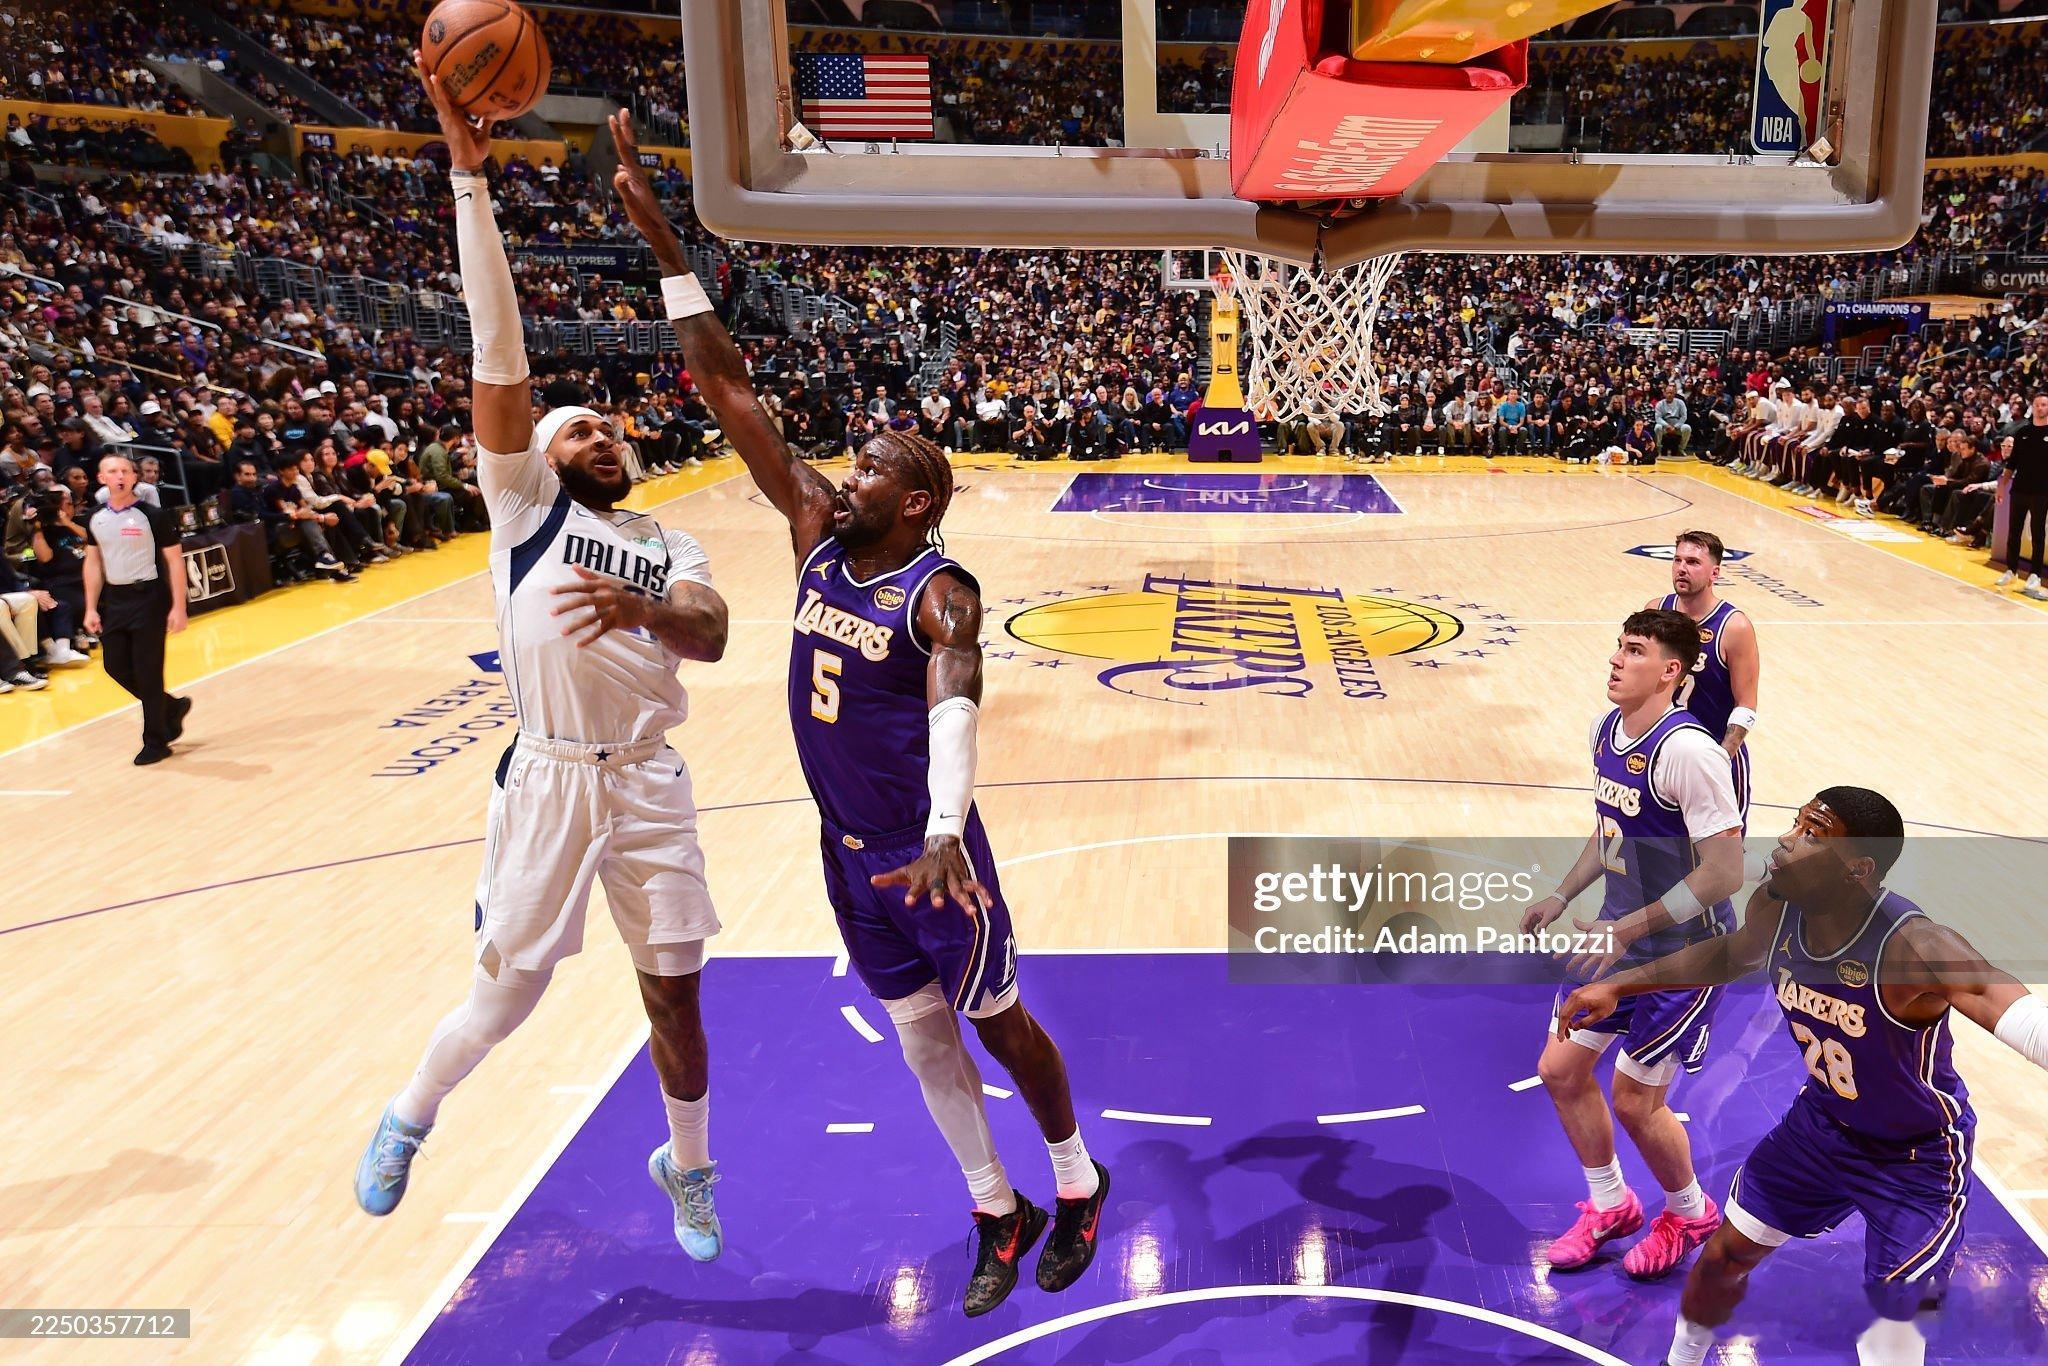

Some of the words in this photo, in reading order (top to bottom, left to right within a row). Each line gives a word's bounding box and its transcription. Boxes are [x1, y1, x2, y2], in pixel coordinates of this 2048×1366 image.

[1761, 116, 1793, 143] NBA
[567, 255, 617, 266] EXPRESS
[2000, 270, 2048, 289] crypt
[1836, 303, 1851, 315] 17x
[1852, 303, 1910, 316] CHAMPIONS
[563, 534, 668, 593] DALLAS
[794, 587, 894, 662] LAKERS
[877, 590, 905, 605] bibigo
[1315, 604, 1357, 628] LOS
[1097, 573, 1345, 706] LAKERS
[1322, 626, 1388, 700] ANGELES
[378, 679, 503, 730] ARENA
[811, 648, 843, 724] 5
[1597, 812, 1627, 876] 12
[1839, 964, 1868, 982] bibigo
[1777, 966, 1867, 1038] LAKERS
[1791, 1021, 1858, 1100] 28
